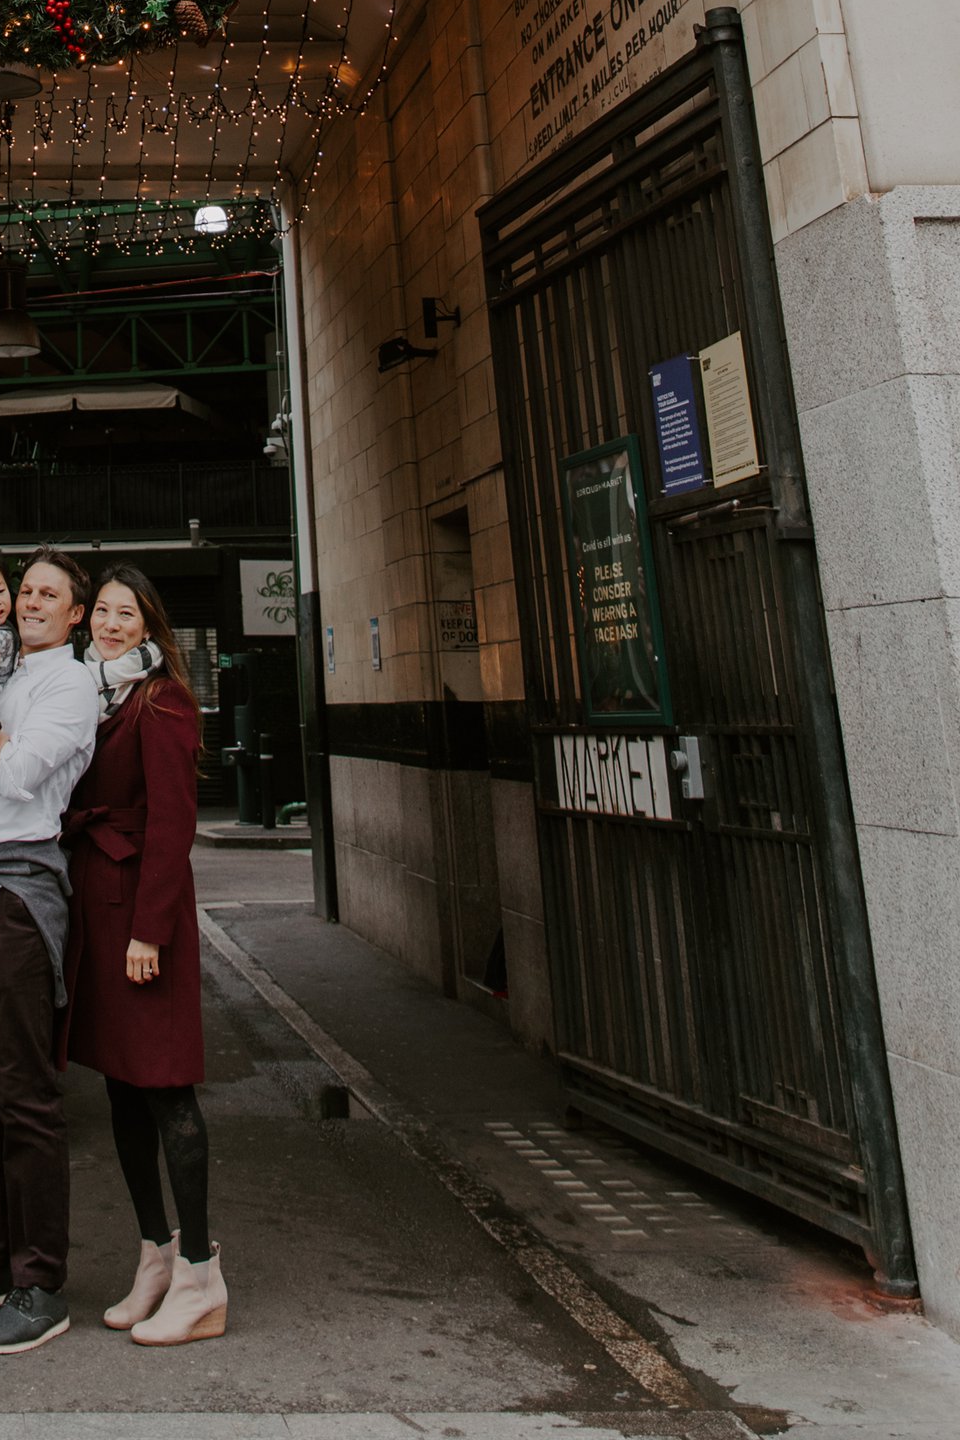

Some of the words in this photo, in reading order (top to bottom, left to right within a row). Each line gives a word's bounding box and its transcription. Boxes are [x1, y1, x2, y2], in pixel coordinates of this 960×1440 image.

[521, 25, 532, 48] NO
[532, 42, 544, 64] ON
[530, 10, 605, 120] ENTRANCE
[528, 123, 553, 160] SPEED
[554, 95, 578, 134] LIMIT
[583, 83, 590, 107] 5
[591, 52, 623, 101] MILES
[626, 26, 647, 65] PER
[593, 581, 631, 602] CONSDER
[592, 603, 628, 622] WEARNG
[629, 602, 637, 617] A
[441, 618, 463, 629] KEEP
[441, 631, 456, 642] OF
[594, 626, 615, 643] FACE
[560, 735, 657, 819] MARKET
